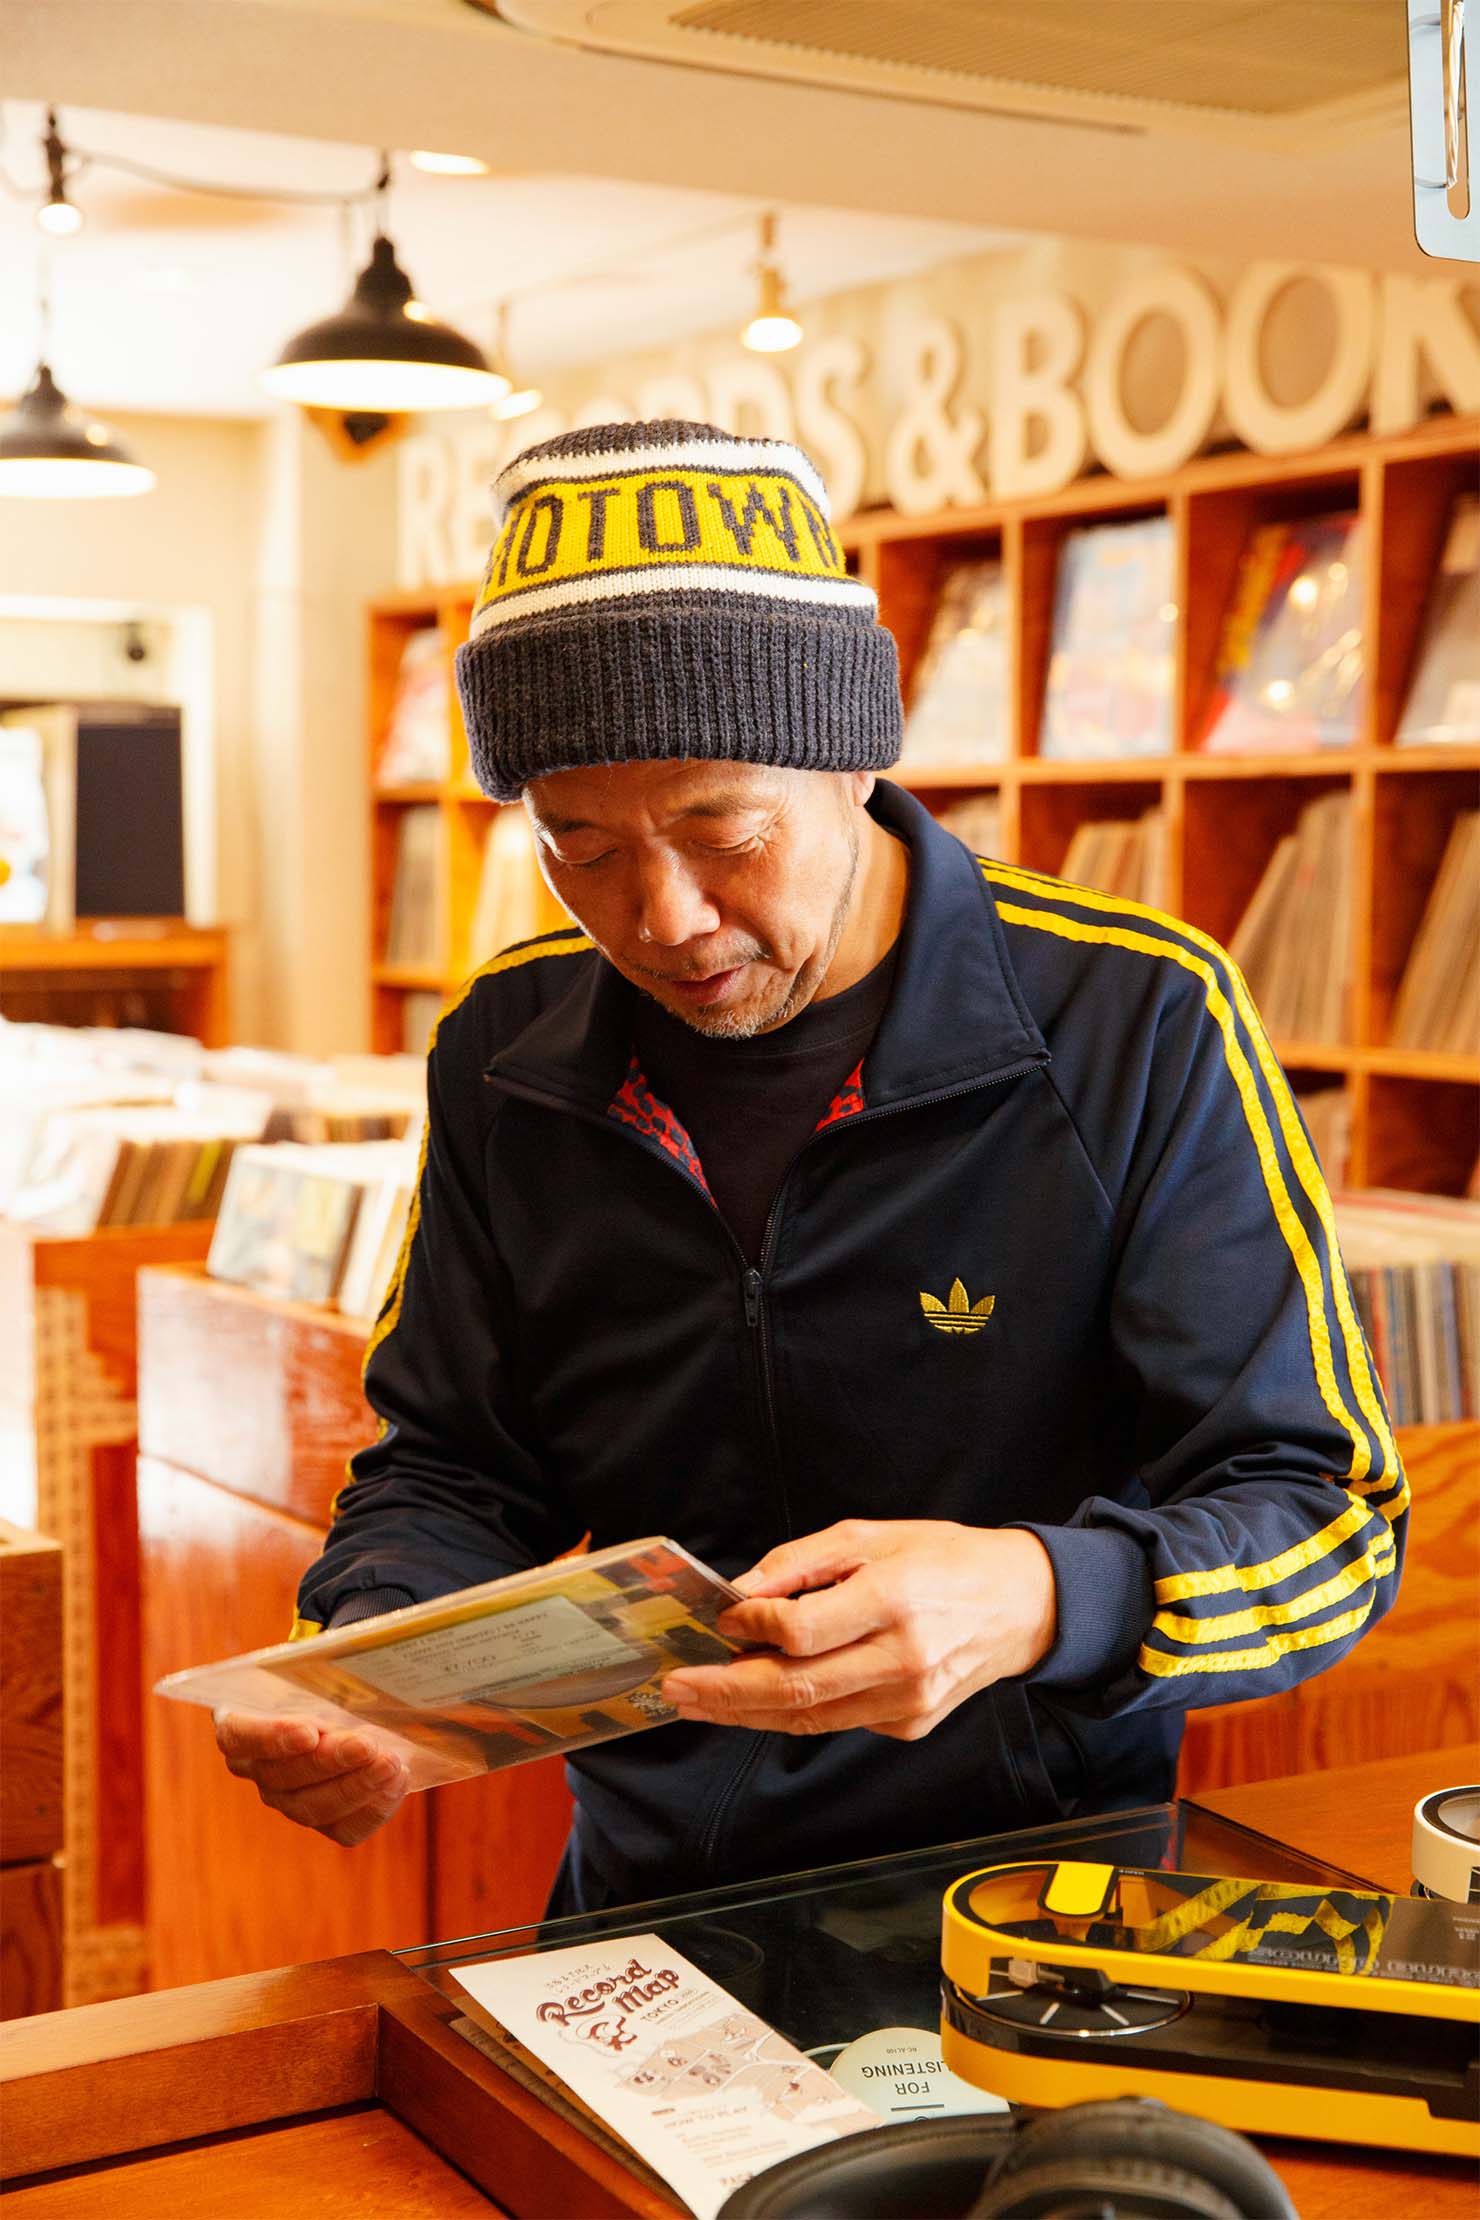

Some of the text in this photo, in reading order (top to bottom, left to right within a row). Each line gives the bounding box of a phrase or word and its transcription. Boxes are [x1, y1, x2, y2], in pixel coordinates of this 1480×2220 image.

[886, 311, 987, 515] &
[536, 1958, 652, 2027] Record
[640, 1998, 680, 2023] TOKYO
[895, 2081, 931, 2096] FOR
